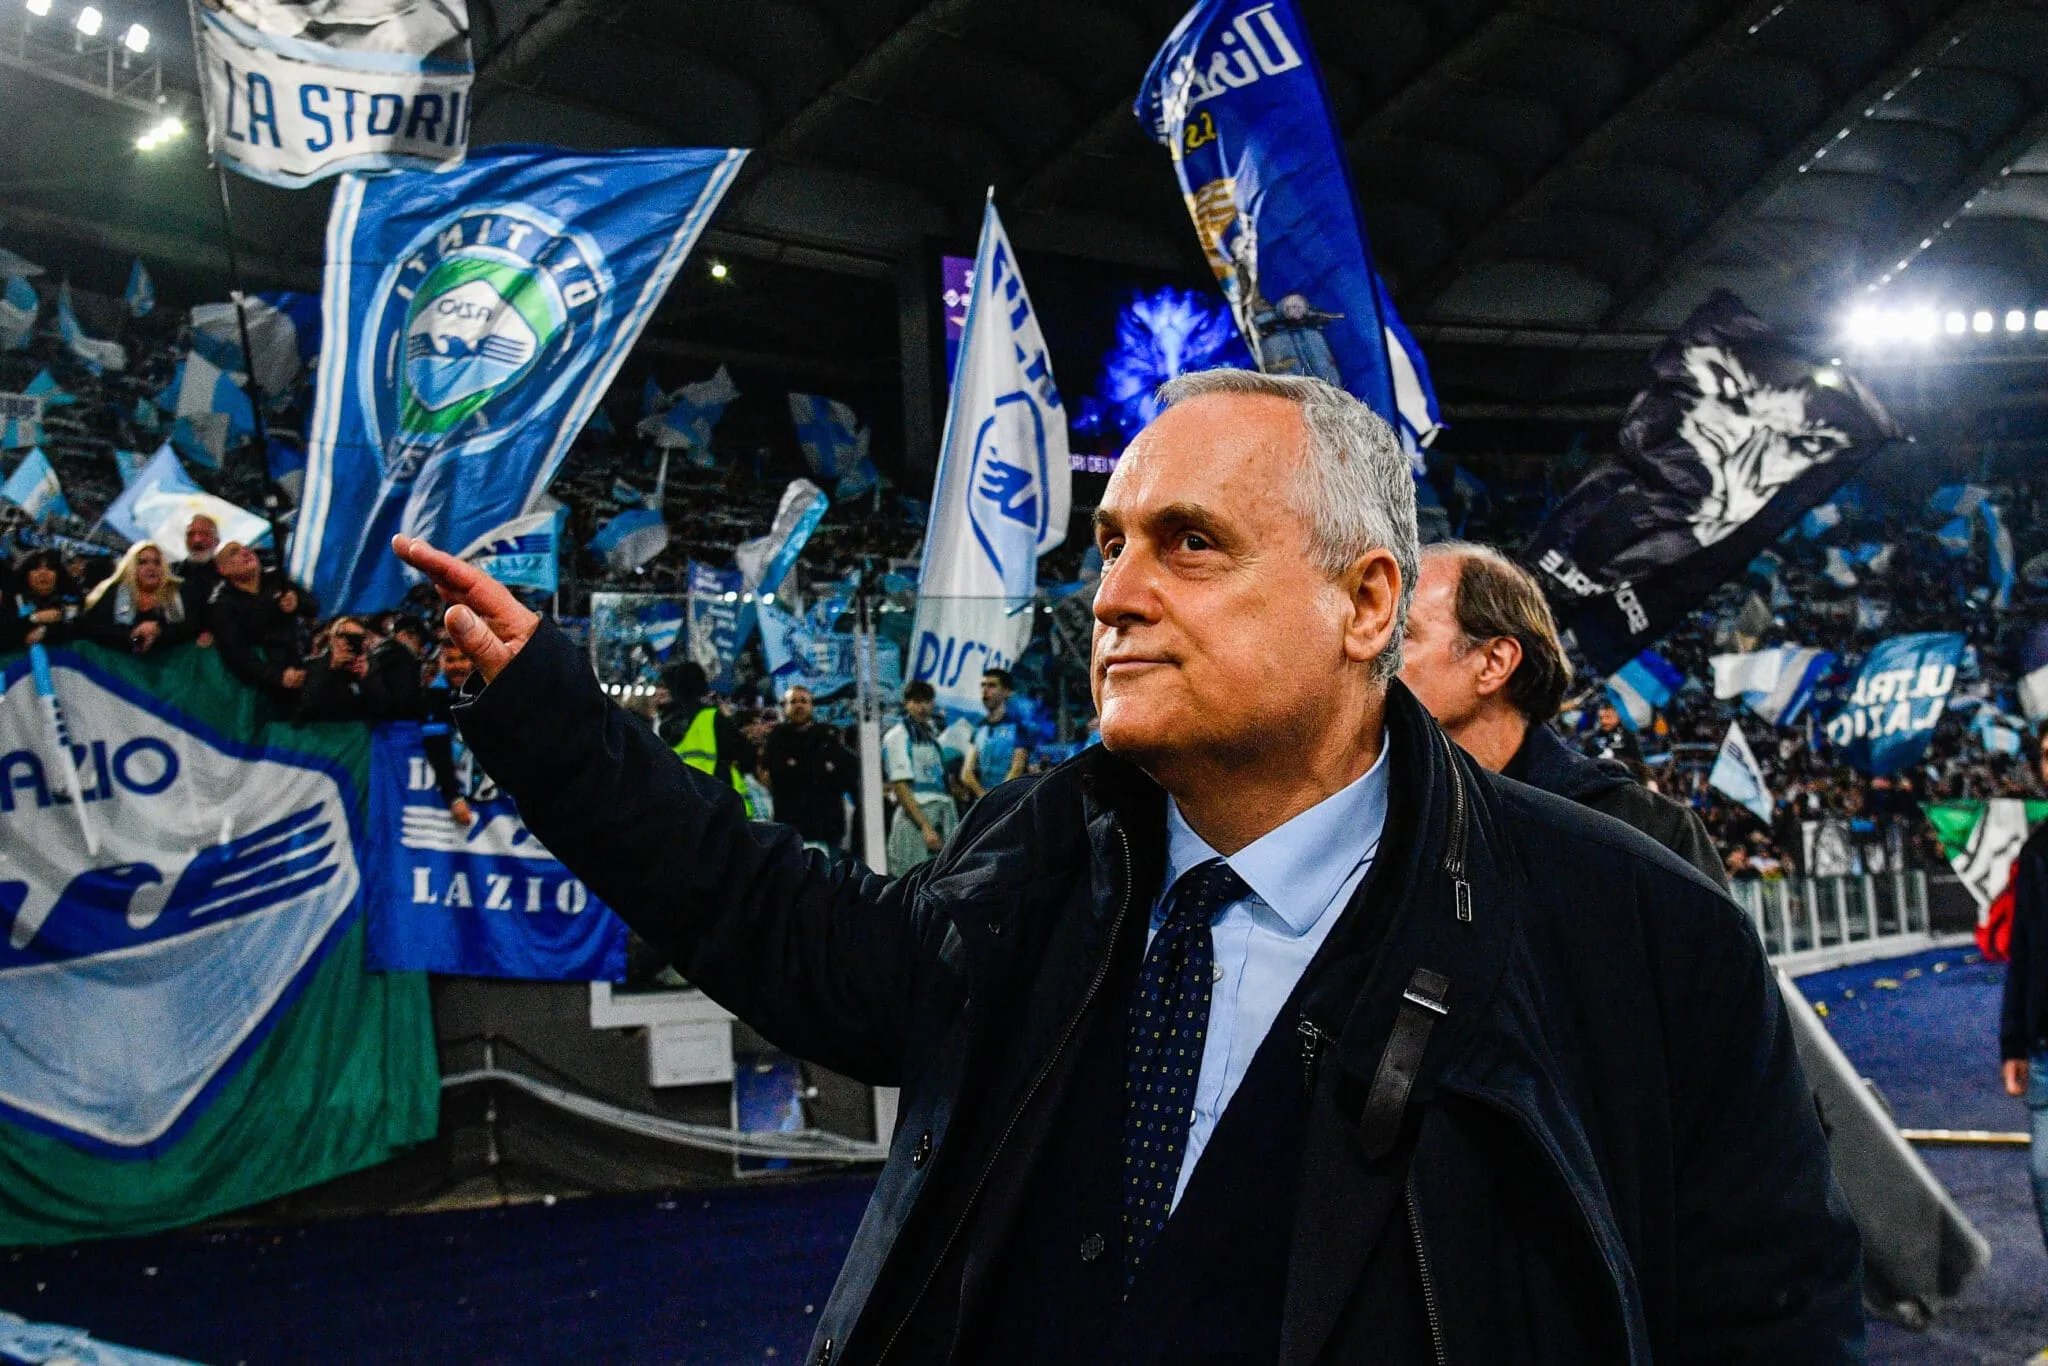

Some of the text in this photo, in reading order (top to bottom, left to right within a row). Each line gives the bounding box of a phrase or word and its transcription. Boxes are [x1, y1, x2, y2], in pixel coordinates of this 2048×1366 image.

[214, 59, 472, 153] LA STORI
[0, 736, 181, 813] AZIO
[411, 866, 589, 915] LAZIO
